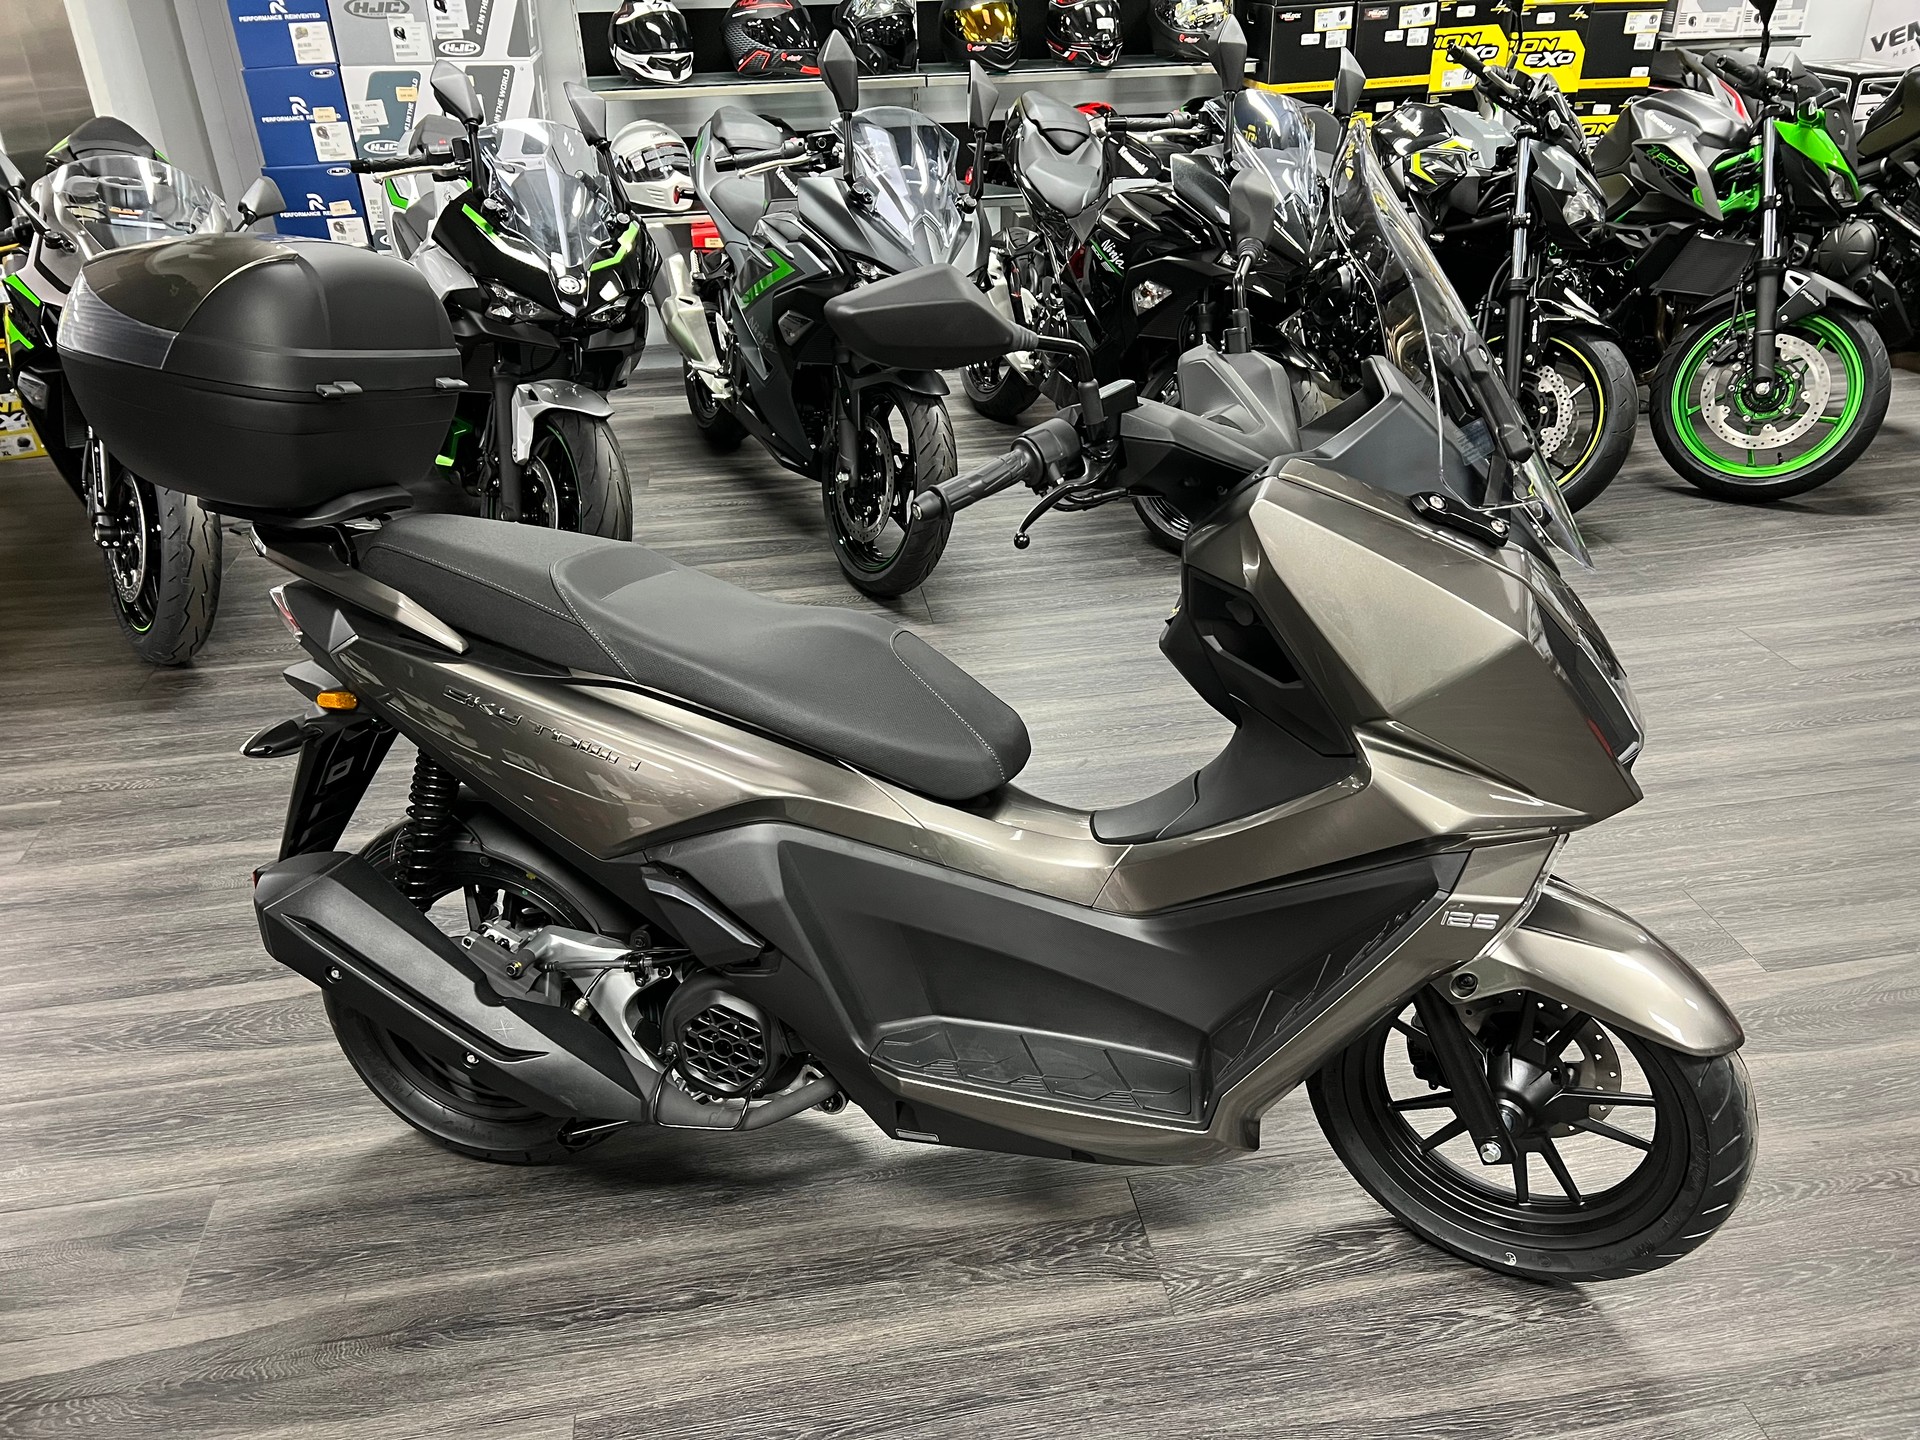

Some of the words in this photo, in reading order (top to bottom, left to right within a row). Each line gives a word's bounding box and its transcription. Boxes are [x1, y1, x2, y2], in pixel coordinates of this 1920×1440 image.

[353, 1, 401, 13] HJC
[238, 14, 283, 22] PERFORMANCE
[284, 12, 321, 20] REINVENTED
[477, 14, 485, 23] IN
[444, 43, 476, 52] HJC
[1433, 32, 1482, 49] ION
[498, 68, 510, 97] WORLD
[495, 97, 504, 113] THE
[261, 115, 305, 123] PERFORMANCE
[493, 114, 500, 122] IN
[1644, 110, 1677, 135] Kawasaki
[370, 143, 398, 151] HJC
[1117, 145, 1149, 176] Kawasaki
[280, 210, 321, 218] PERFORMANCE
[1100, 238, 1125, 270] Ninja
[749, 315, 778, 354] Ninja
[1440, 910, 1500, 930] 125
